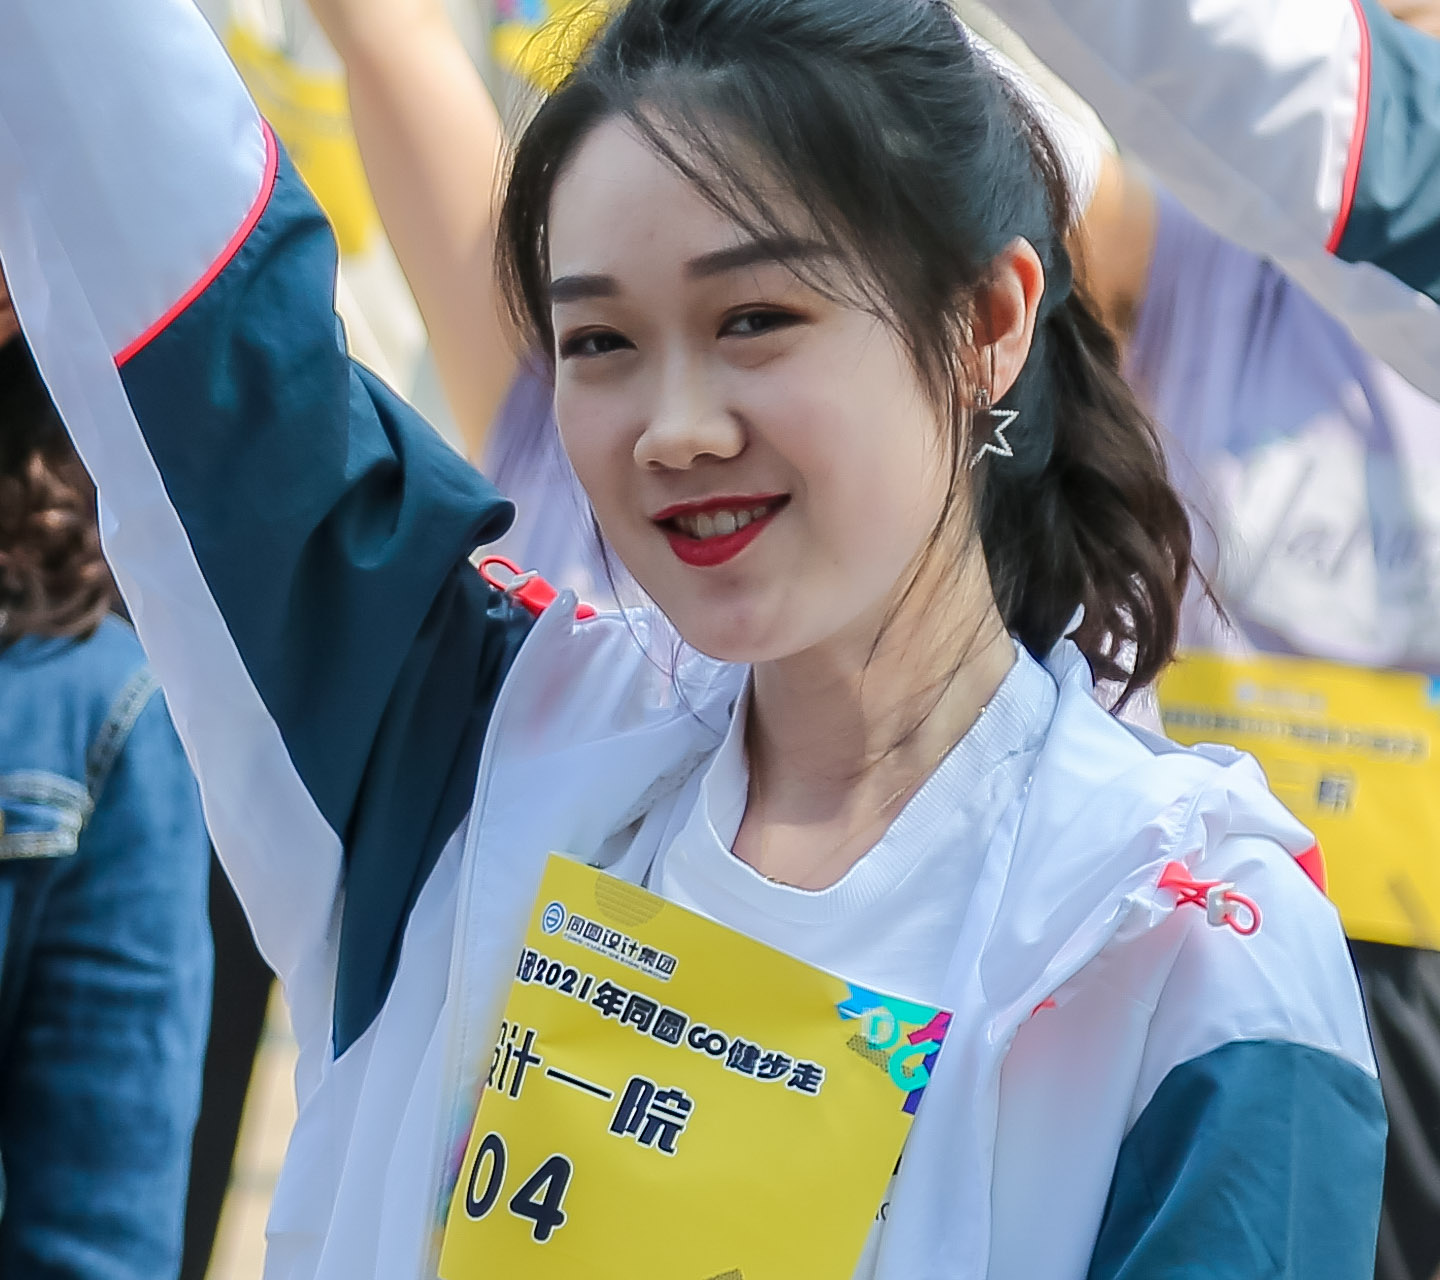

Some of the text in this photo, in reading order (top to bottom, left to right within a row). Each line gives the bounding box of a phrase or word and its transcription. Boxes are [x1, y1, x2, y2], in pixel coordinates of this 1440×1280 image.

[567, 914, 678, 976] 同圆设计集团
[516, 948, 824, 1094] 团2021年同圆GO健步走
[465, 1132, 574, 1241] 04
